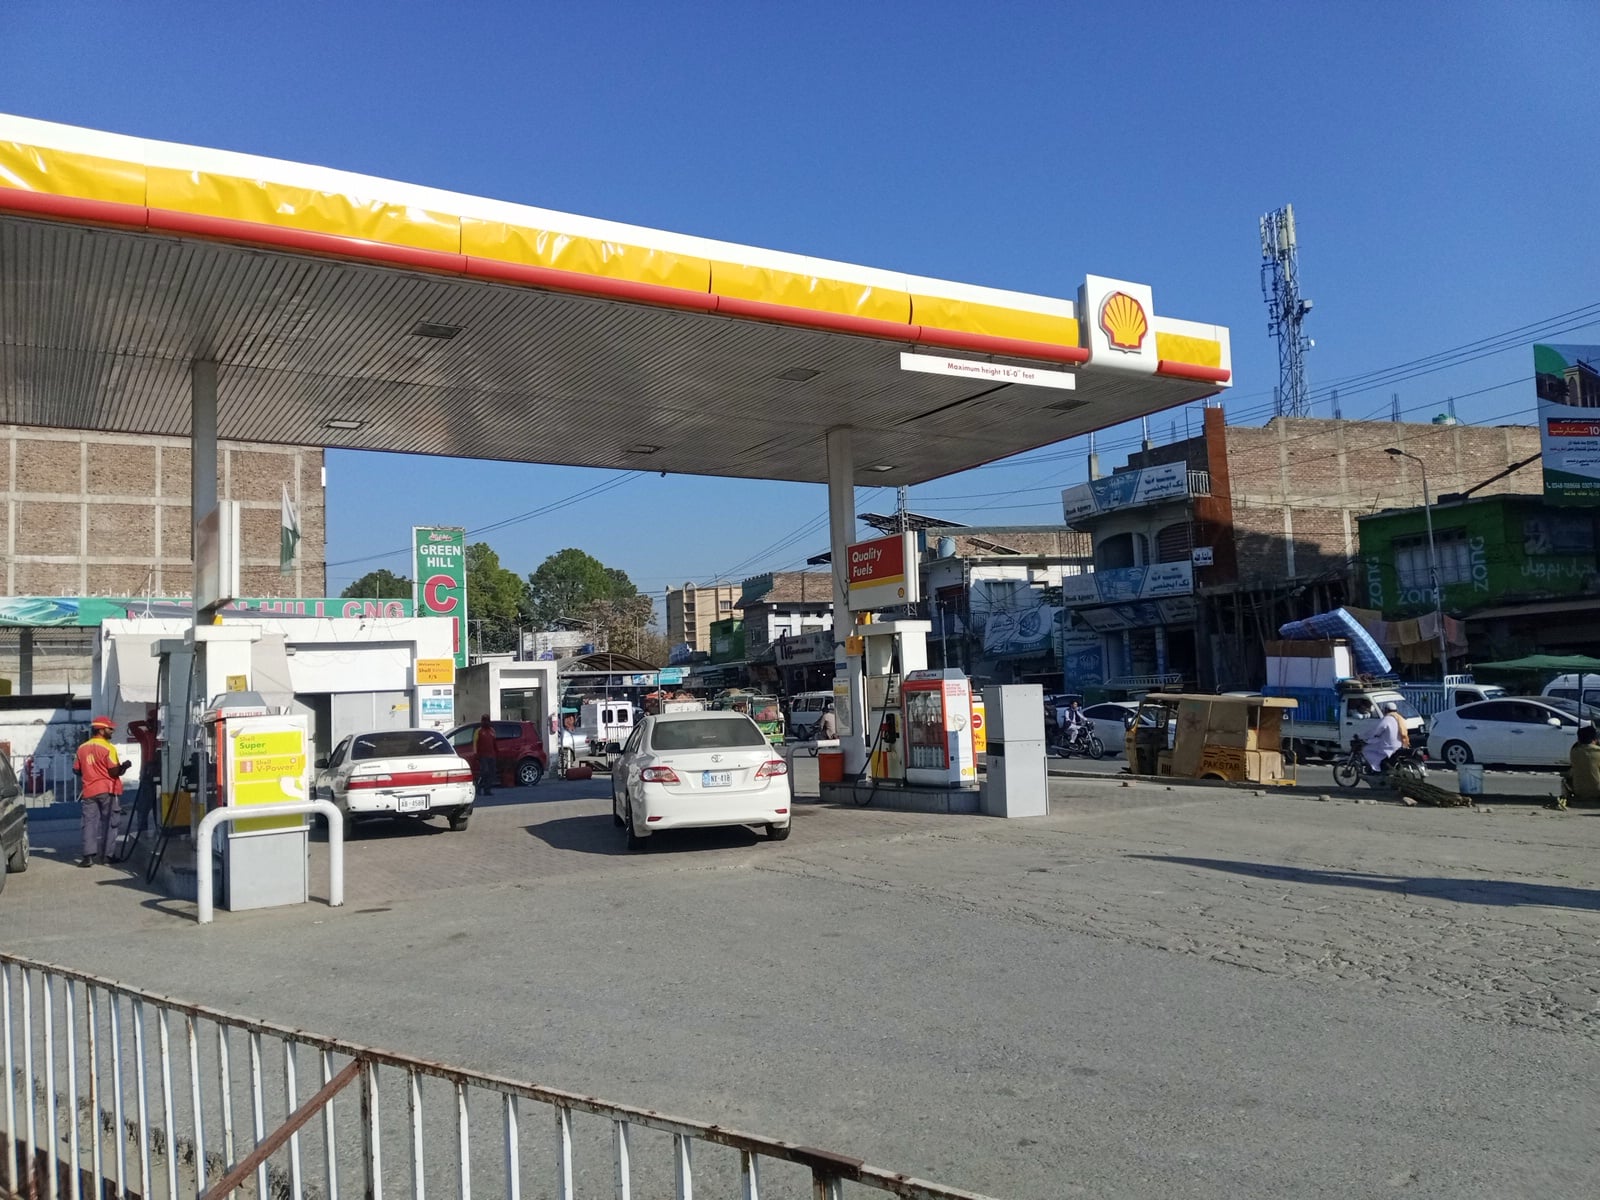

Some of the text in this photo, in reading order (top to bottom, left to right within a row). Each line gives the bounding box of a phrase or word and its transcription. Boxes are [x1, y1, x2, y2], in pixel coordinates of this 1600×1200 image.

[947, 362, 980, 372] Maximum
[981, 366, 1001, 376] height
[1022, 371, 1035, 379] feet
[419, 544, 461, 556] GREEN
[852, 547, 882, 563] Quality
[427, 557, 454, 568] HILL
[853, 562, 873, 577] Fuels
[342, 601, 405, 618] CNG
[239, 742, 266, 750] Super
[256, 764, 294, 772] V-Power
